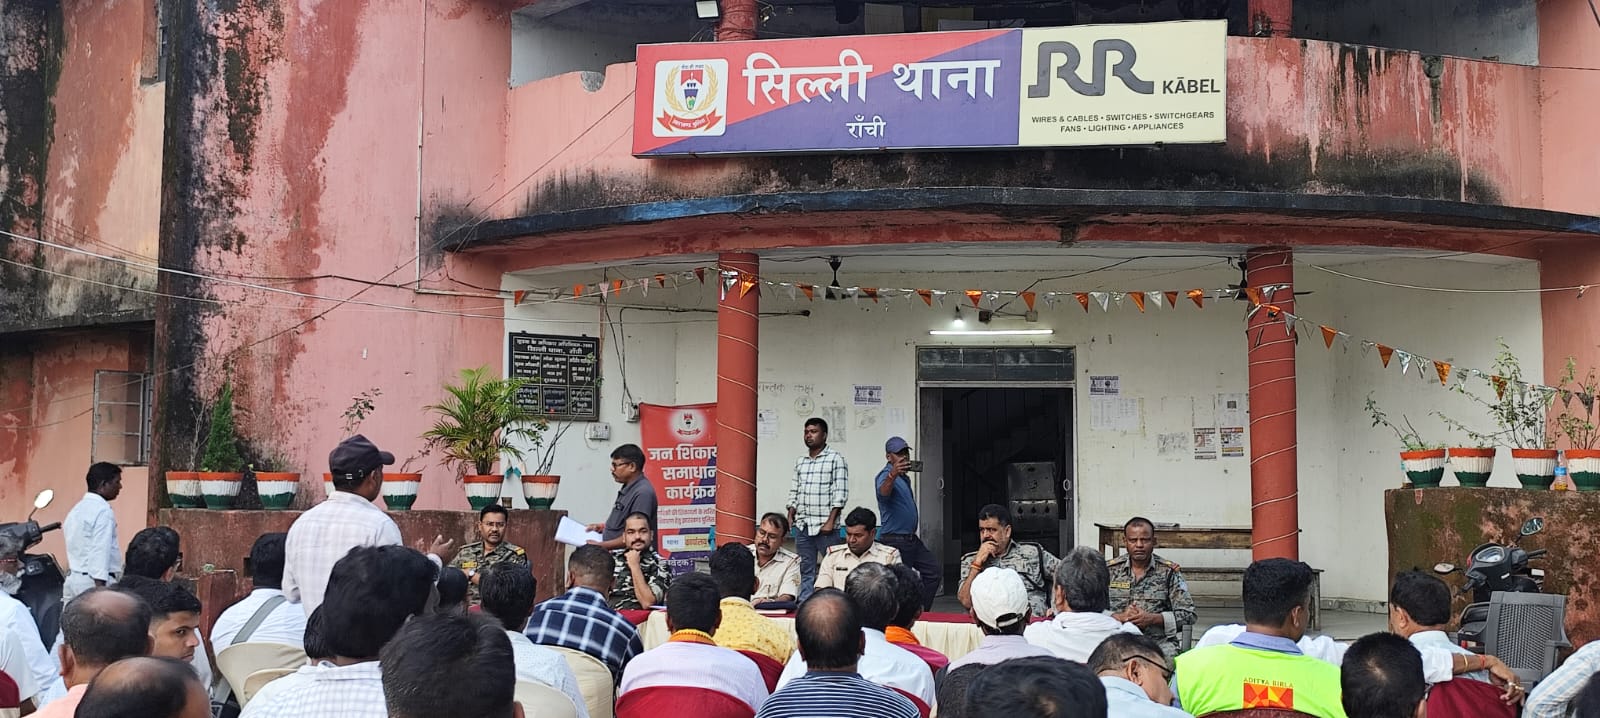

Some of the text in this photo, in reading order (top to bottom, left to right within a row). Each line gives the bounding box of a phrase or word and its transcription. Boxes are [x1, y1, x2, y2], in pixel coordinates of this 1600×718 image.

[742, 48, 1001, 105] सिल्ली थाना
[1028, 39, 1220, 98] RR KĀBEL
[1031, 115, 1057, 123] WIRES
[1067, 114, 1099, 122] CABLES
[1105, 113, 1147, 121] SWITCHES
[1154, 111, 1215, 120] SWITCHGEARS
[846, 114, 886, 138] राँची
[1060, 122, 1184, 133] FANS LIGHTING APPLIANCES
[647, 443, 717, 460] जन शिकाय
[1243, 677, 1270, 685] ADITYA
